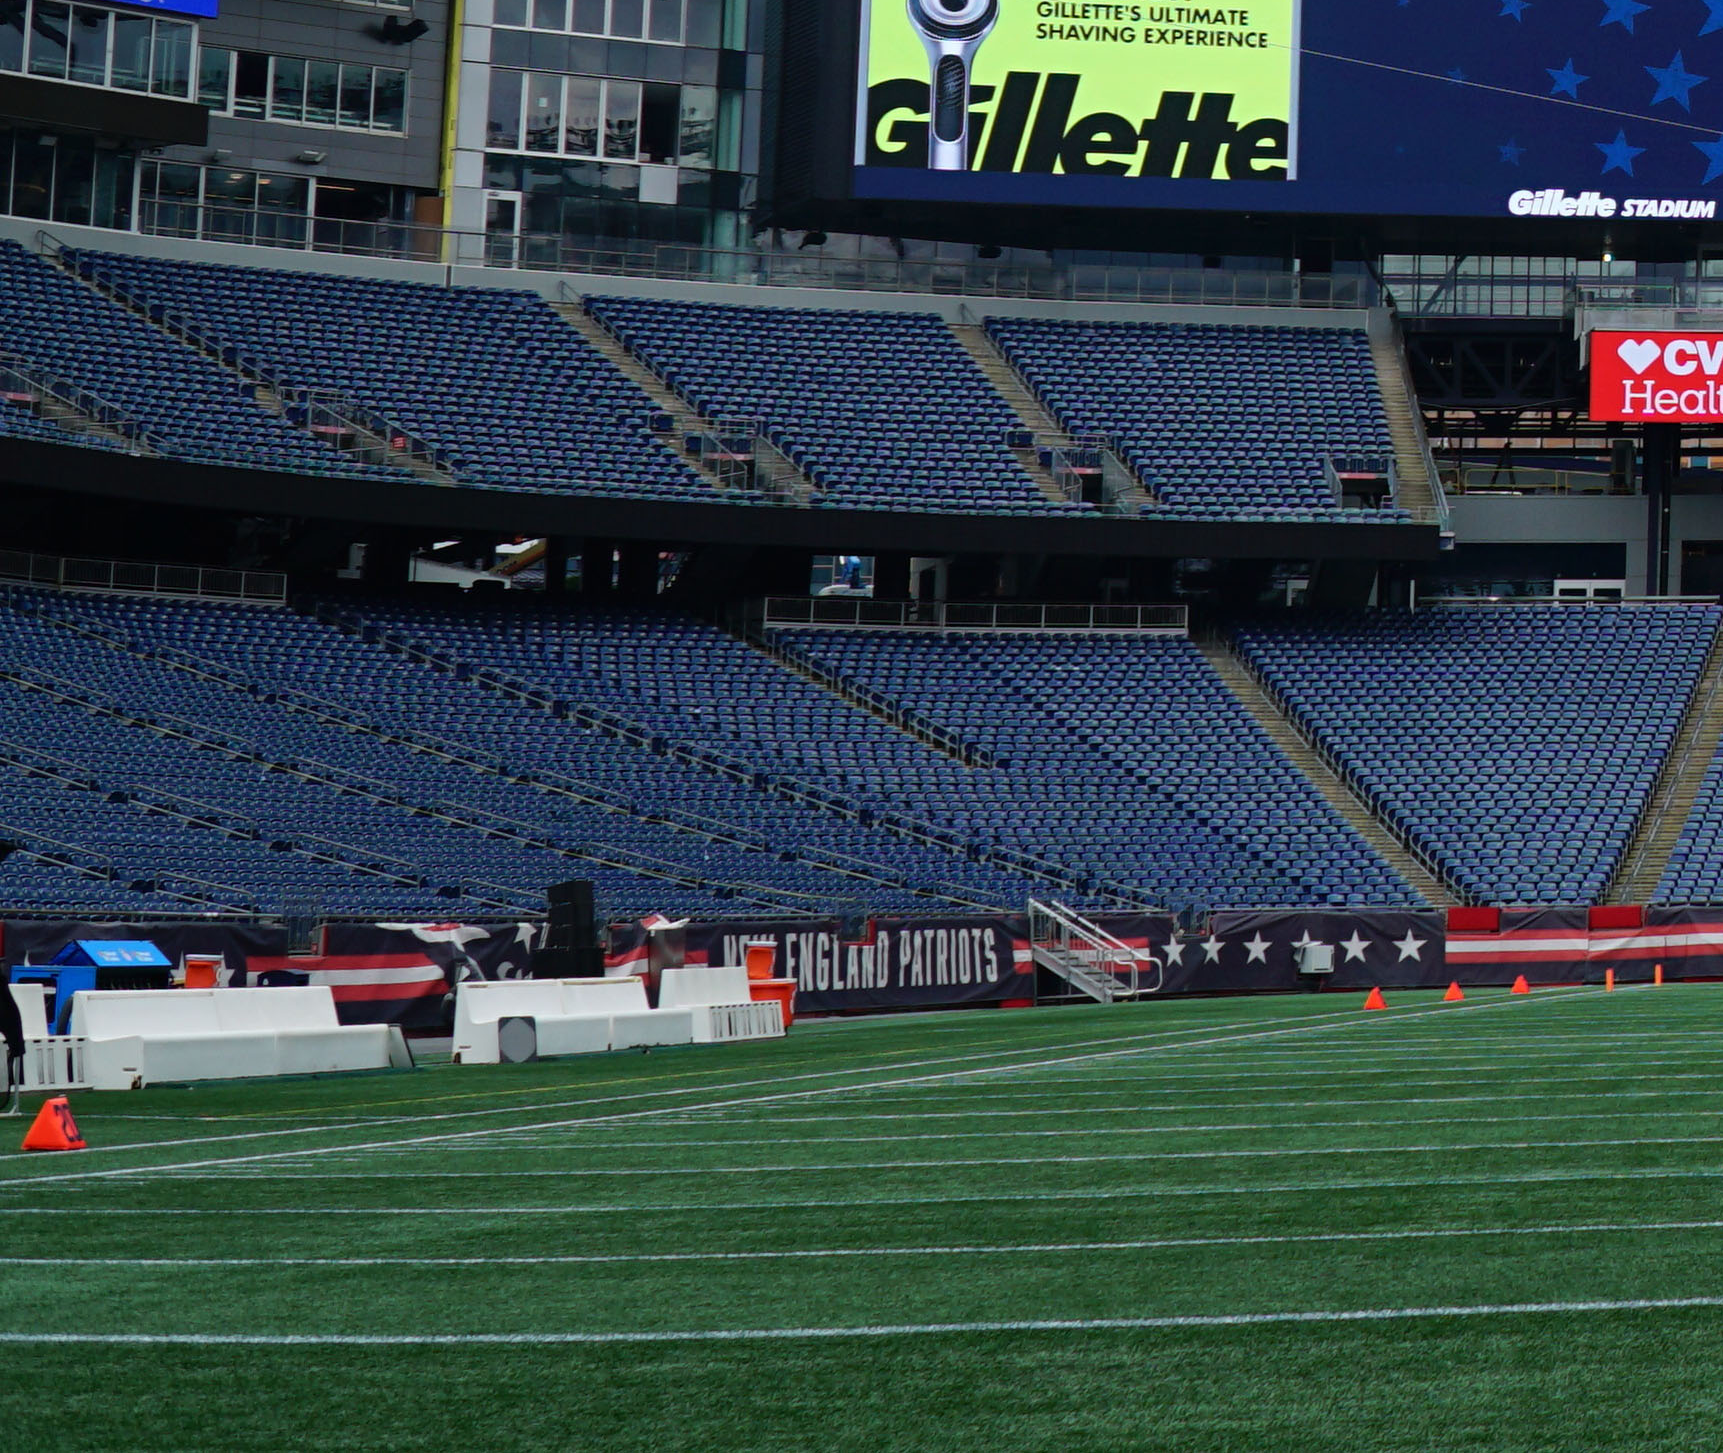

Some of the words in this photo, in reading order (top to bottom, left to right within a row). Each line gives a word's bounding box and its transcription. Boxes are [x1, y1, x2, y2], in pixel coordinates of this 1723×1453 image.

[1037, 1, 1140, 21] GILLETTE'S
[1150, 7, 1248, 25] ULTIMATE
[1037, 23, 1135, 43] SHAVING
[1145, 28, 1267, 48] EXPERIENCE
[866, 71, 1290, 179] Gillette
[1509, 189, 1616, 217] Gillette
[1621, 199, 1716, 218] STADIUM
[786, 930, 890, 992] ENGLAND
[899, 928, 998, 986] PATRIOTS
